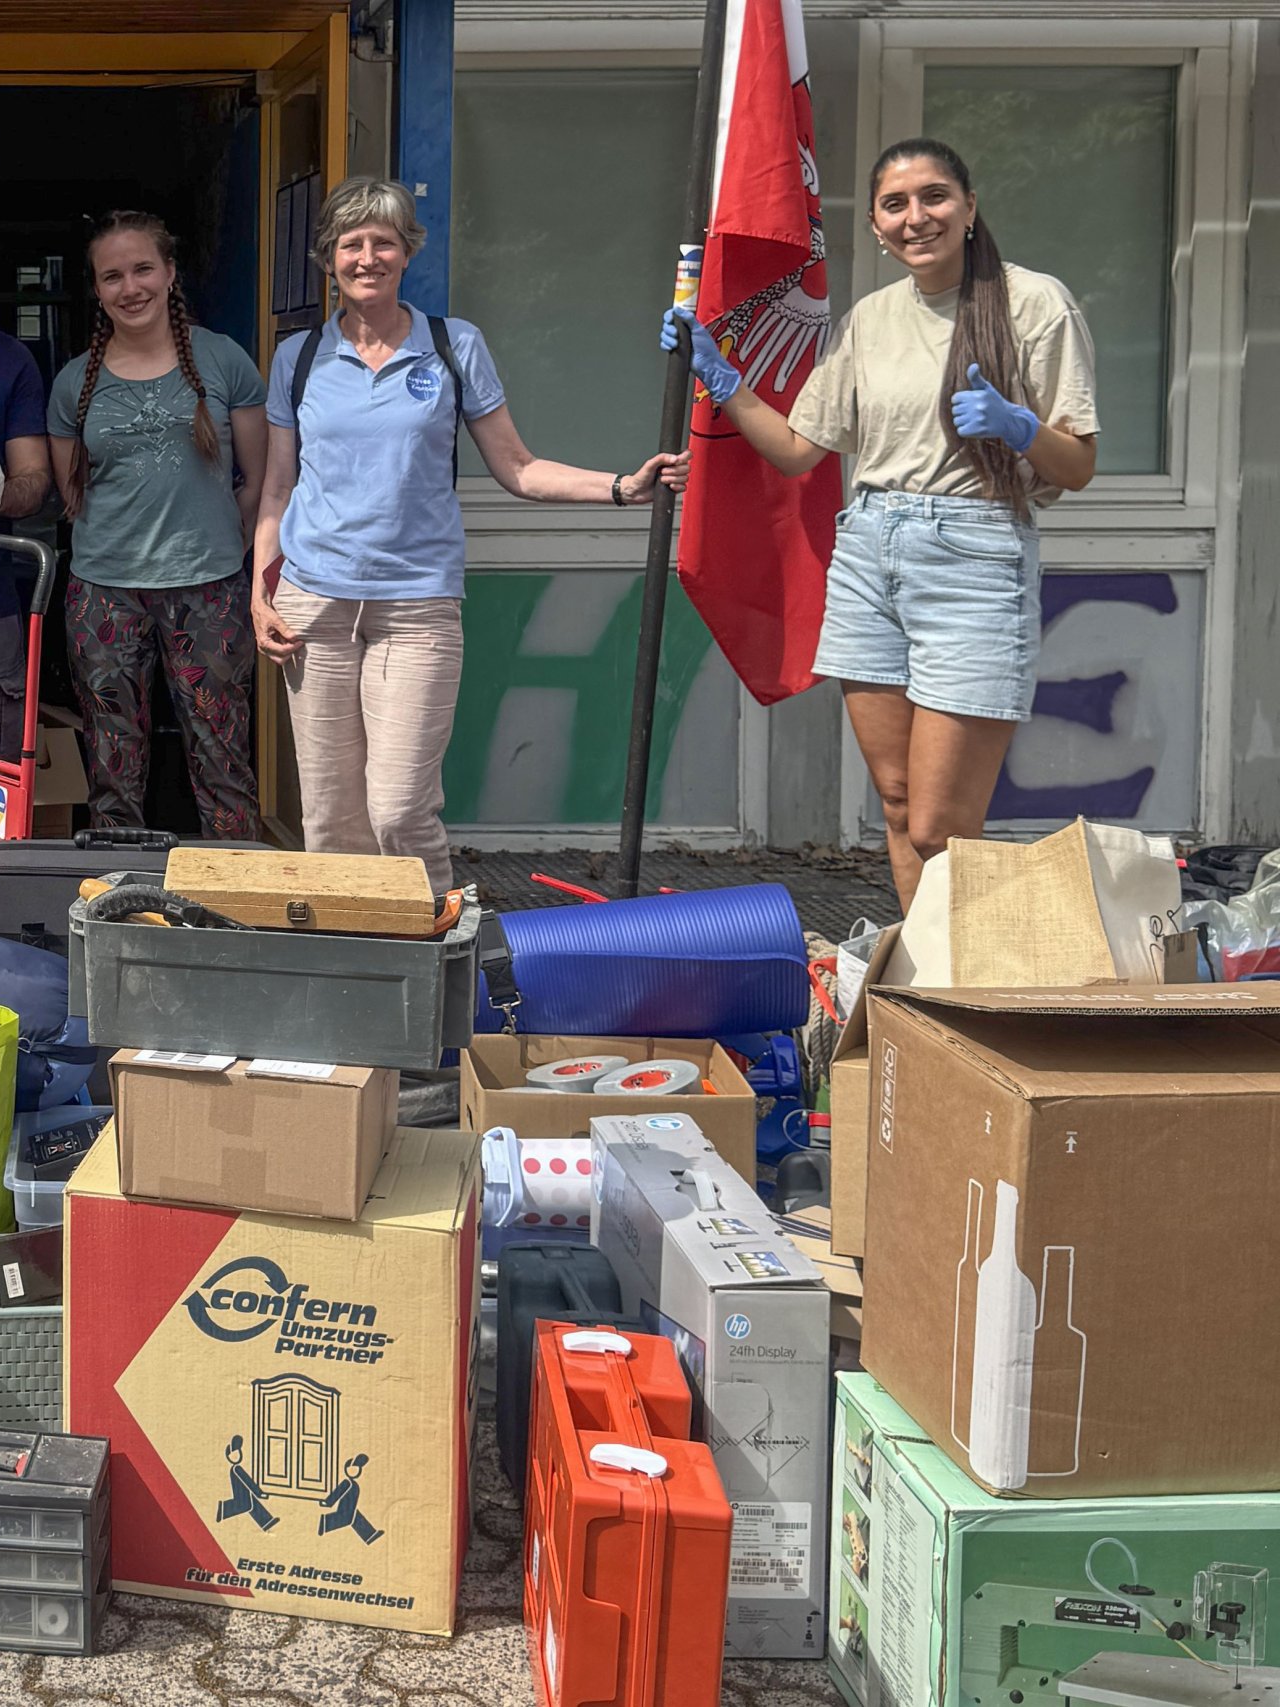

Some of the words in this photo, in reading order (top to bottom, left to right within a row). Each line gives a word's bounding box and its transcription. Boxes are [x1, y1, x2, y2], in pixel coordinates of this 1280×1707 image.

[209, 1283, 378, 1327] confern
[280, 1319, 394, 1348] Umzugs-
[728, 1314, 748, 1338] hp
[274, 1337, 384, 1365] Partner
[729, 1345, 755, 1357] 24fh
[757, 1345, 797, 1359] Display
[236, 1557, 286, 1577] Erste
[288, 1564, 363, 1586] Adresse
[185, 1567, 214, 1584] für
[214, 1571, 252, 1589] den
[254, 1577, 415, 1611] Adressenwechsel
